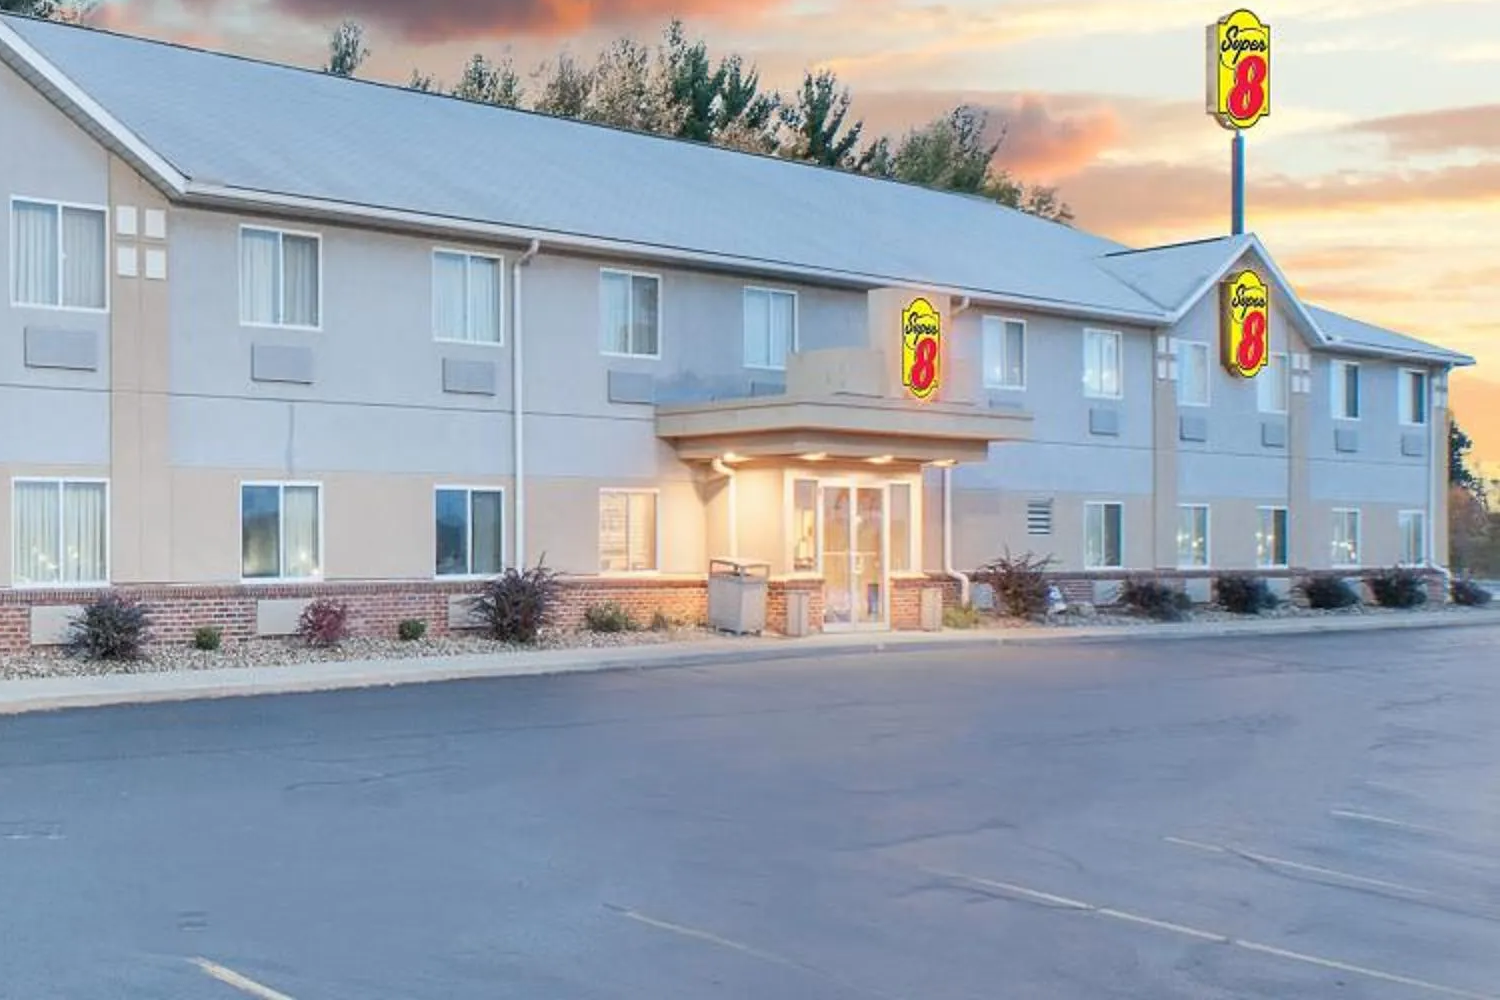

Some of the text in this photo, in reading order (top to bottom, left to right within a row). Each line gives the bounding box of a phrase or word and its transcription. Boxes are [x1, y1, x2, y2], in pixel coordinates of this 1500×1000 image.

[1221, 25, 1267, 64] Super
[1228, 55, 1266, 119] 8
[1232, 284, 1265, 320] Super
[905, 311, 938, 345] Super
[1237, 311, 1265, 369] 8
[911, 338, 937, 389] 8
